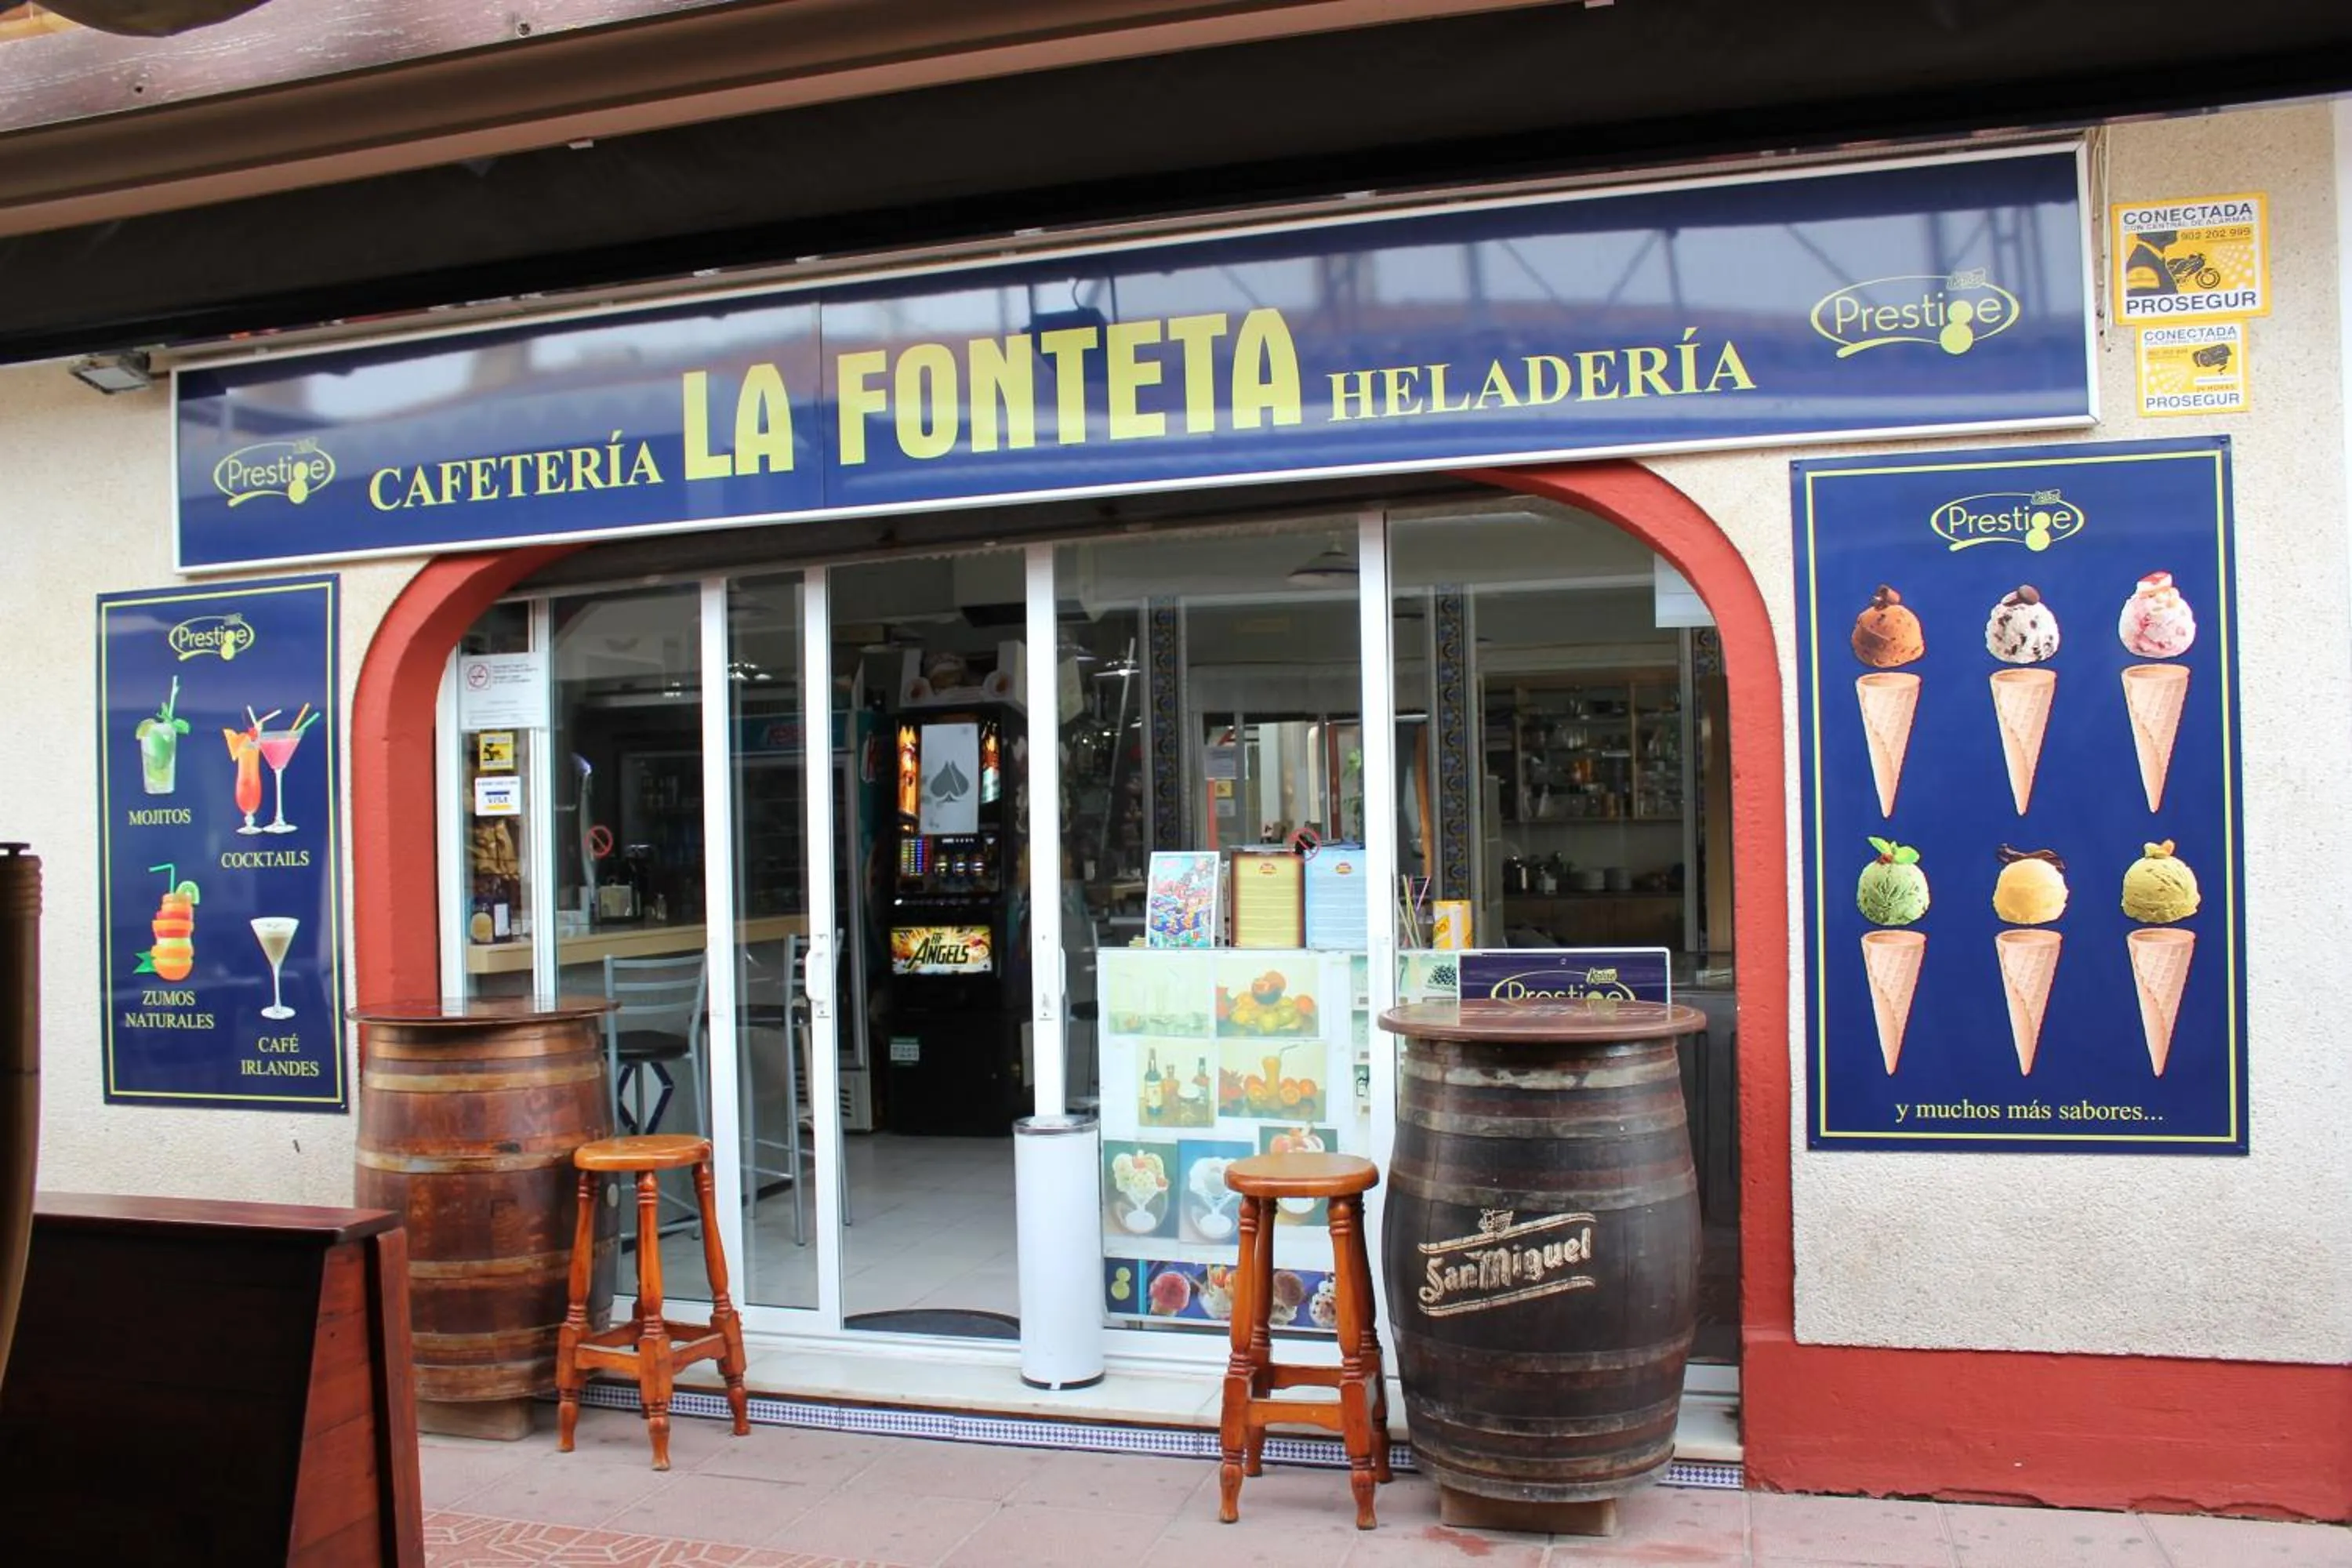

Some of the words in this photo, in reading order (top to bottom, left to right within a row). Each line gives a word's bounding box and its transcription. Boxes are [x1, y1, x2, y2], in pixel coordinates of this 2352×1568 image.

[2123, 203, 2252, 225] CONECTADA
[2147, 221, 2186, 230] CENTRAL
[2205, 216, 2253, 225] ALARMAS
[2205, 229, 2227, 238] 202
[2125, 291, 2257, 314] PROSEGUR
[1835, 291, 2002, 355] Prestige
[2144, 326, 2237, 341] CONECTADA
[369, 430, 663, 511] CAFETERÍA
[683, 363, 794, 481] LA
[837, 308, 1302, 466] FONTETA
[1327, 326, 1757, 422] HELADERÍA
[2146, 393, 2241, 408] PROSEGUR
[228, 455, 326, 504] Prestige
[1949, 506, 2072, 551] Prestige
[129, 808, 191, 826] MOJITOS
[220, 851, 310, 868] COCKTAILS
[903, 936, 970, 970] ANGELS
[142, 990, 195, 1007] ZUMOS
[1508, 981, 1624, 1000] Ptie
[125, 1012, 215, 1029] NATURALES
[258, 1033, 299, 1053] CAFÉ
[241, 1059, 320, 1077] IRLANDES
[1895, 1103, 1909, 1123] y
[1916, 1099, 2001, 1120] muchos
[2008, 1099, 2052, 1120] más
[2059, 1100, 2164, 1121] sabores...
